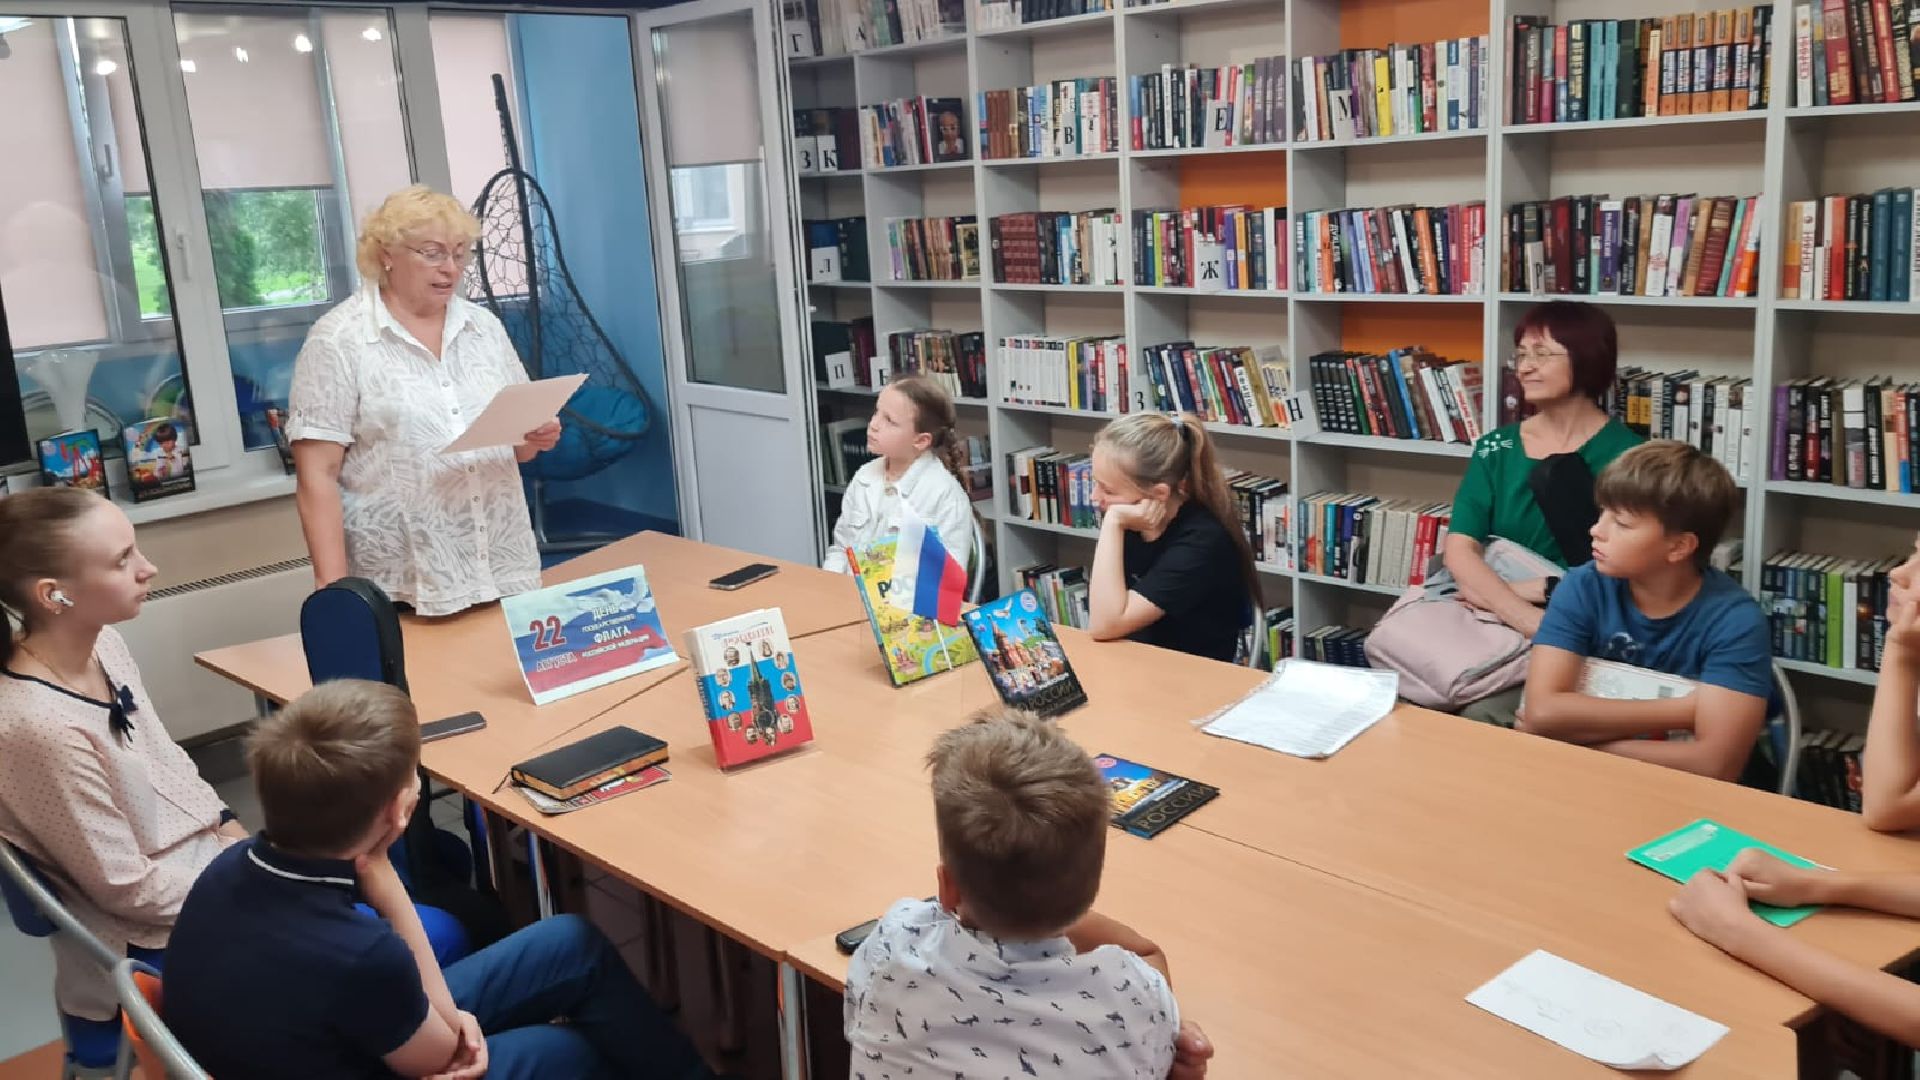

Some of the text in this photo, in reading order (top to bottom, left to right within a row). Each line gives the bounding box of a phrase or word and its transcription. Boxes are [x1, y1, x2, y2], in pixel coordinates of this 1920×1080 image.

[1064, 126, 1074, 145] В
[823, 150, 837, 169] К
[1200, 259, 1220, 280] Ж
[1286, 397, 1304, 422] Н
[592, 603, 620, 621] ДЕНЬ
[529, 615, 567, 651] 22
[594, 625, 631, 643] ФЛАГА
